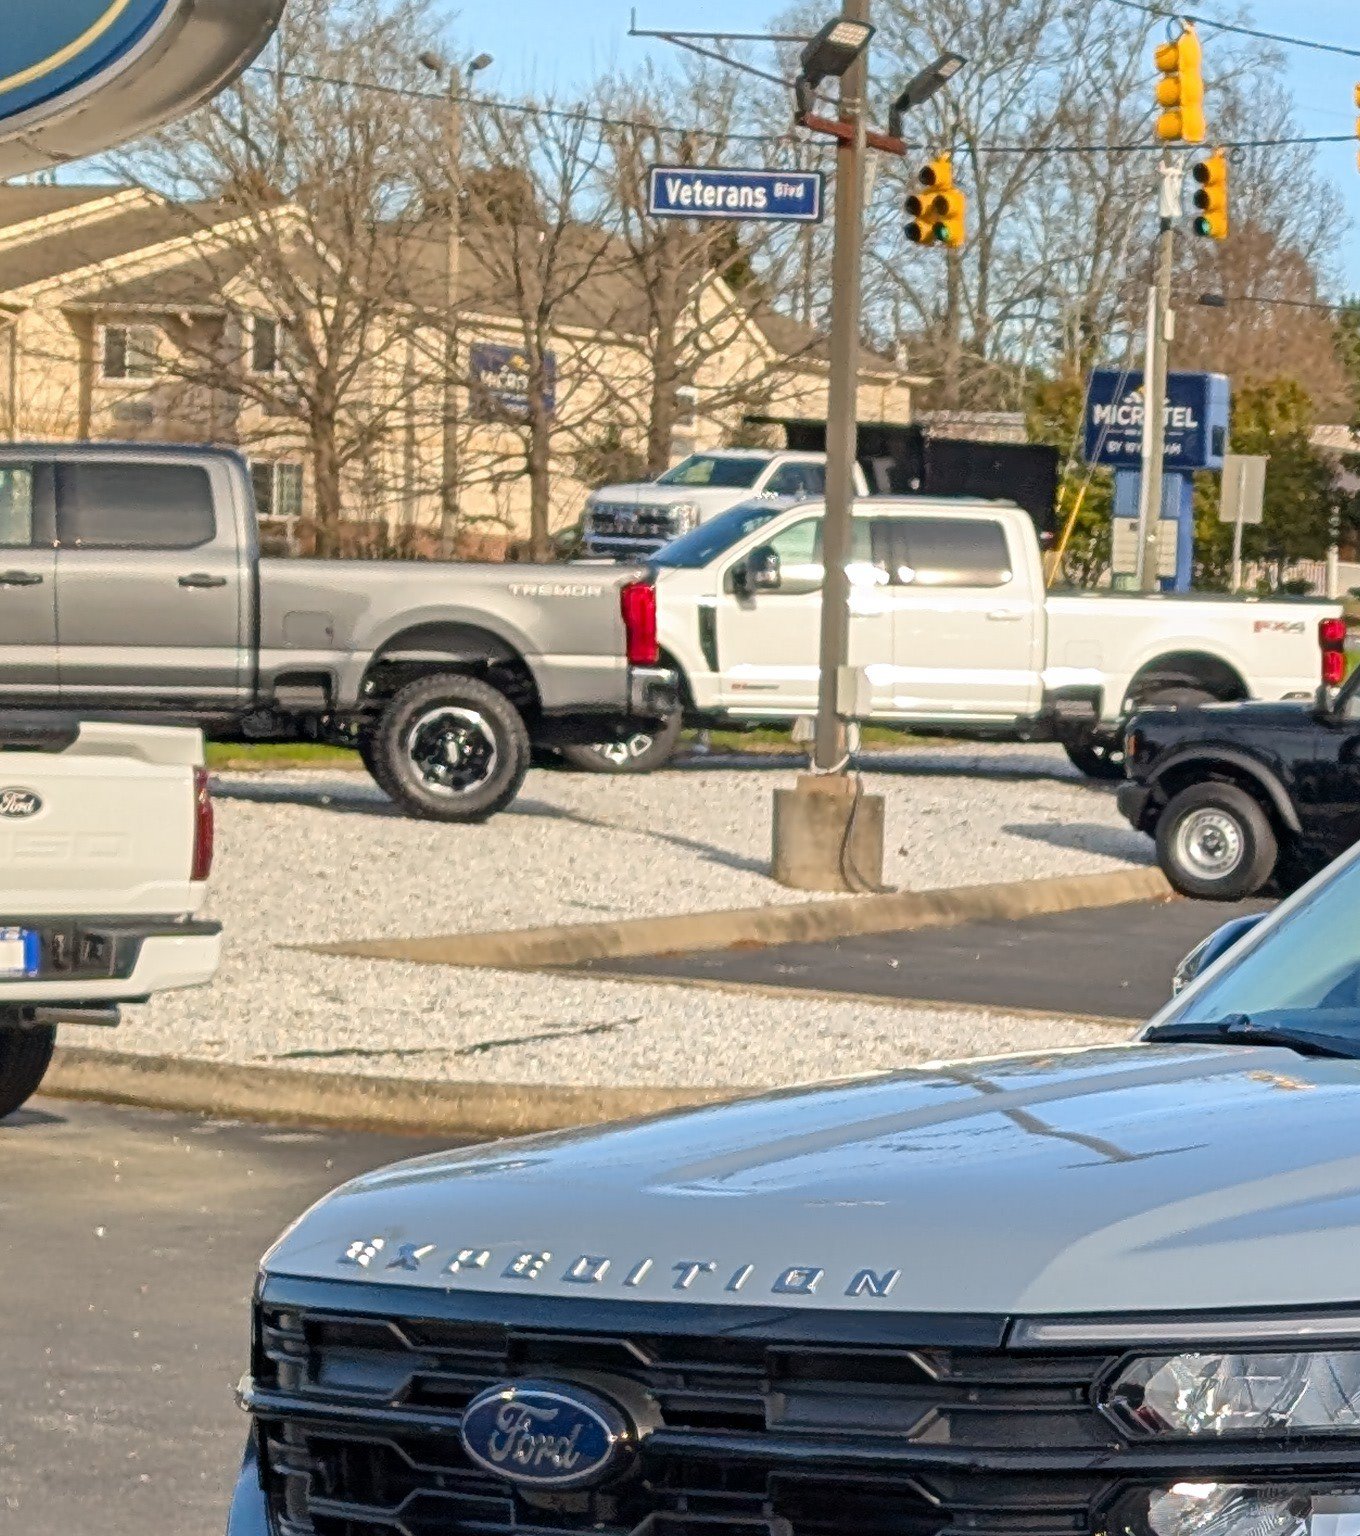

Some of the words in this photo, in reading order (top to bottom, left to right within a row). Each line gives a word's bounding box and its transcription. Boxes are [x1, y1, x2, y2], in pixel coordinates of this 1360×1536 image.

[665, 177, 767, 209] Veterans
[773, 181, 805, 199] Blvd
[1093, 403, 1199, 429] MICRTEL
[507, 583, 603, 598] TREMOR
[1253, 620, 1305, 635] FX4
[336, 1237, 903, 1298] EXPEDITION
[488, 1402, 584, 1470] Ford
